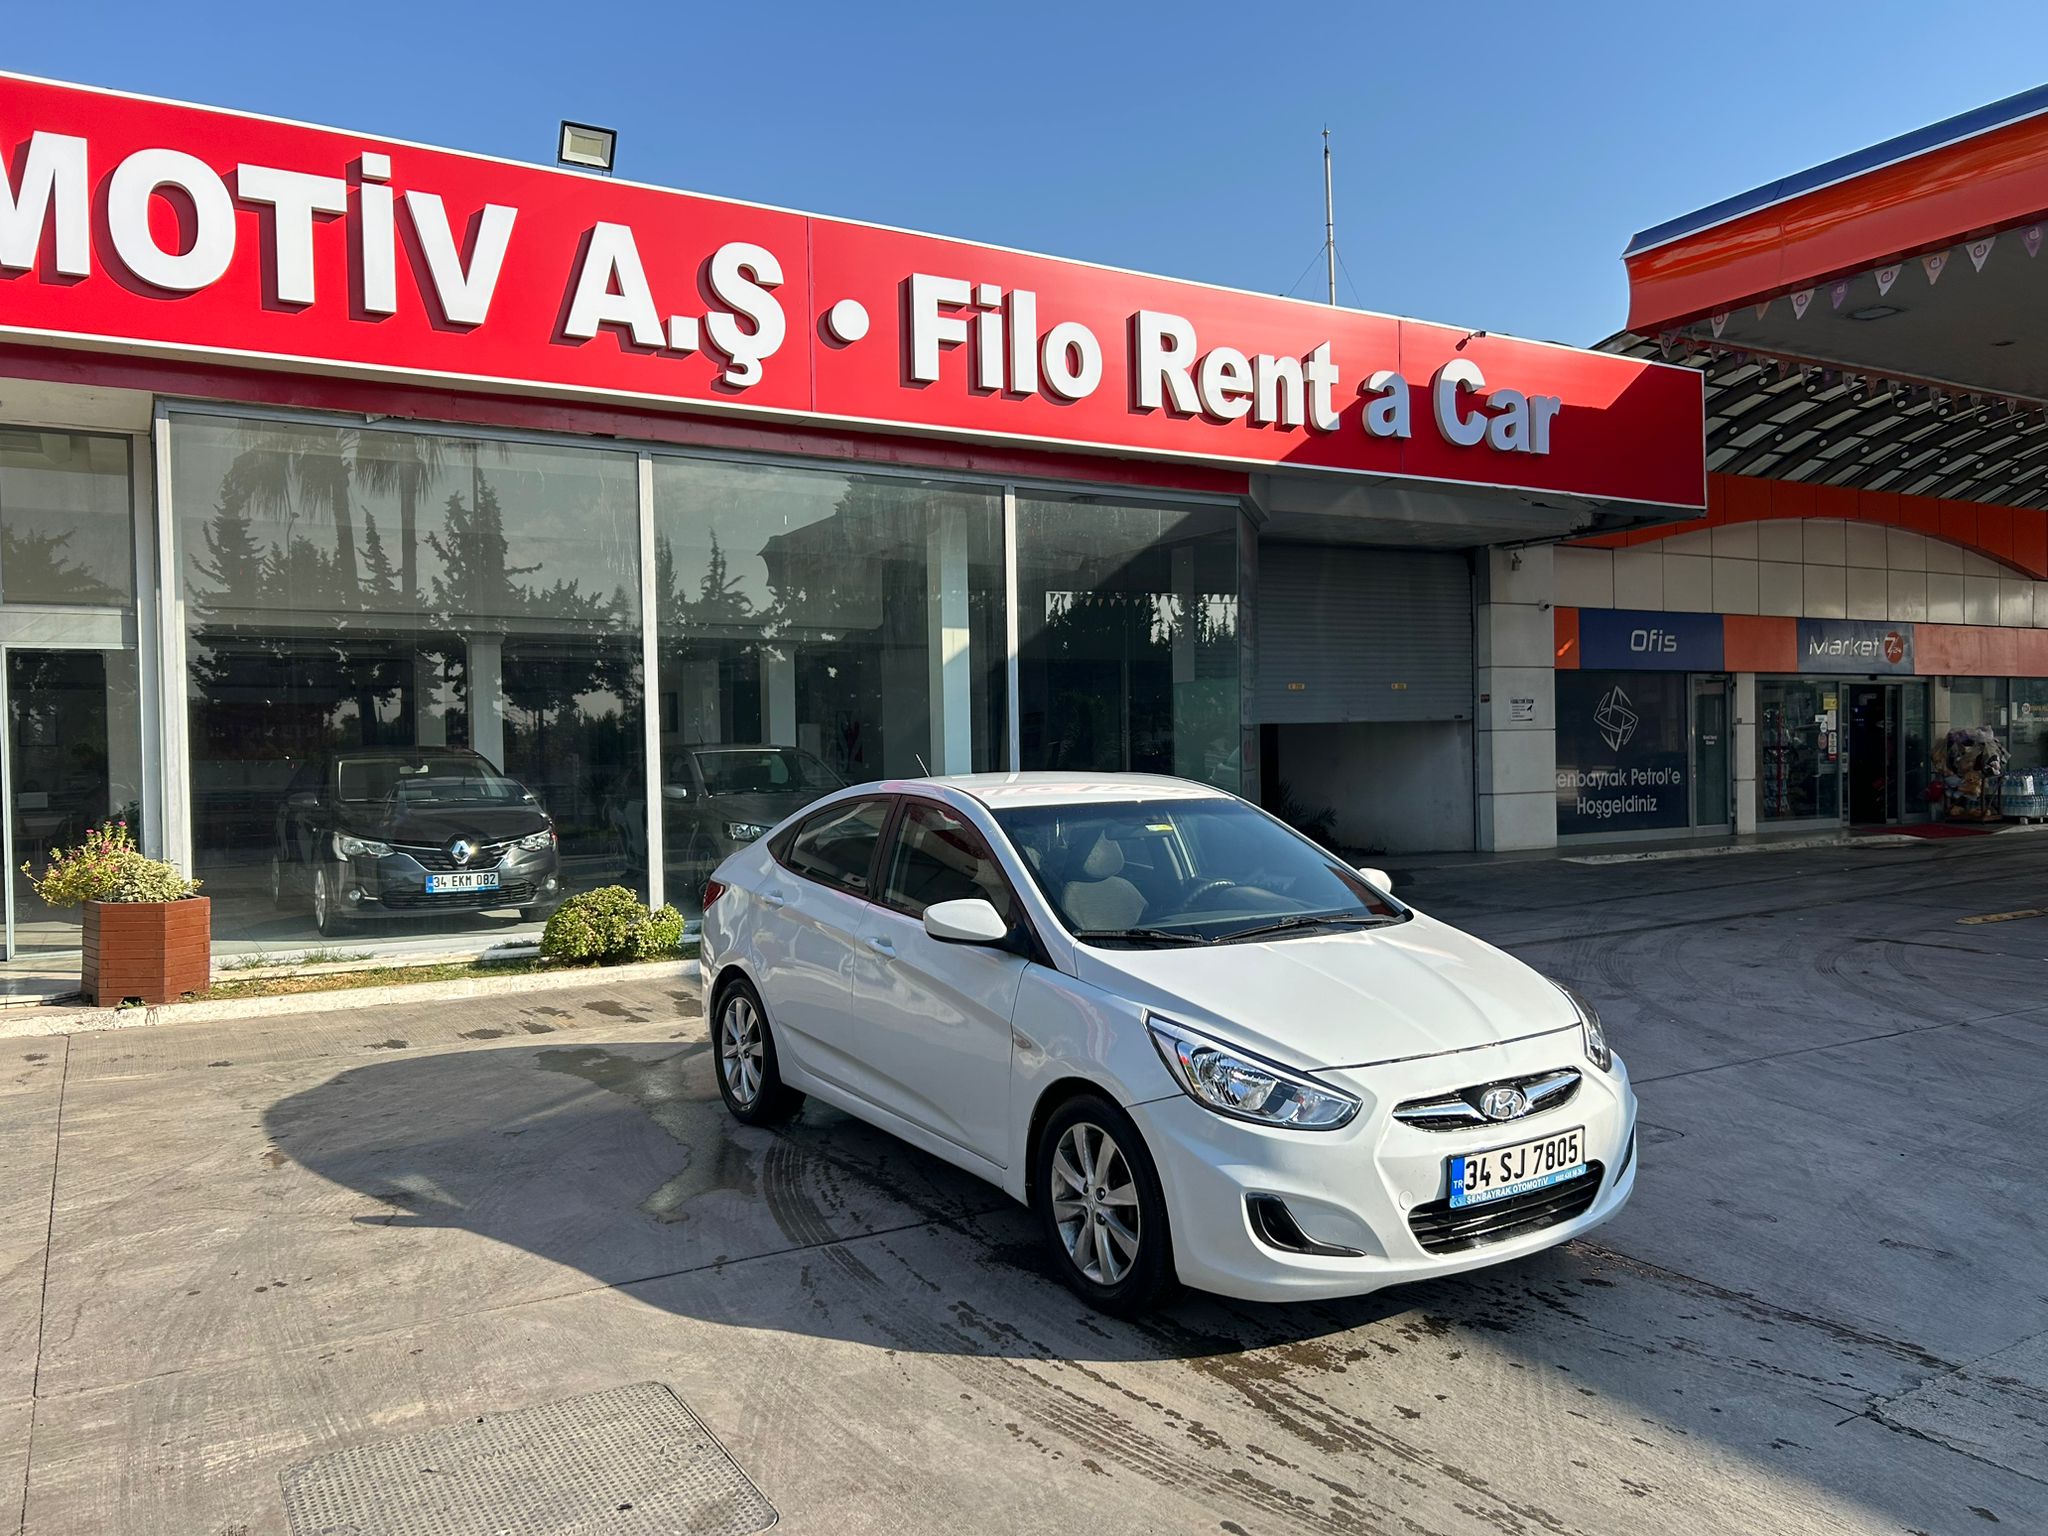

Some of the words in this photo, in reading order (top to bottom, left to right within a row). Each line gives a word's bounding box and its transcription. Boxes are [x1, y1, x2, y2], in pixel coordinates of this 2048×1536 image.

[0, 131, 518, 325] MOTİV
[909, 272, 1104, 399] Filo
[1136, 308, 1341, 431] Rent
[1363, 370, 1411, 439] a
[1432, 357, 1562, 456] Car
[1630, 629, 1677, 652] Ofis
[1809, 634, 1879, 657] Market
[1557, 769, 1627, 791] enbayrak
[1631, 767, 1681, 786] Petrol'e
[1576, 795, 1657, 819] Hoşgeldiniz
[433, 876, 447, 888] 34
[451, 875, 472, 887] EKM
[476, 873, 496, 886] 082
[1465, 1157, 1491, 1191] 34
[1499, 1148, 1526, 1183] SJ
[1533, 1133, 1578, 1175] 7805
[1453, 1179, 1464, 1189] TR
